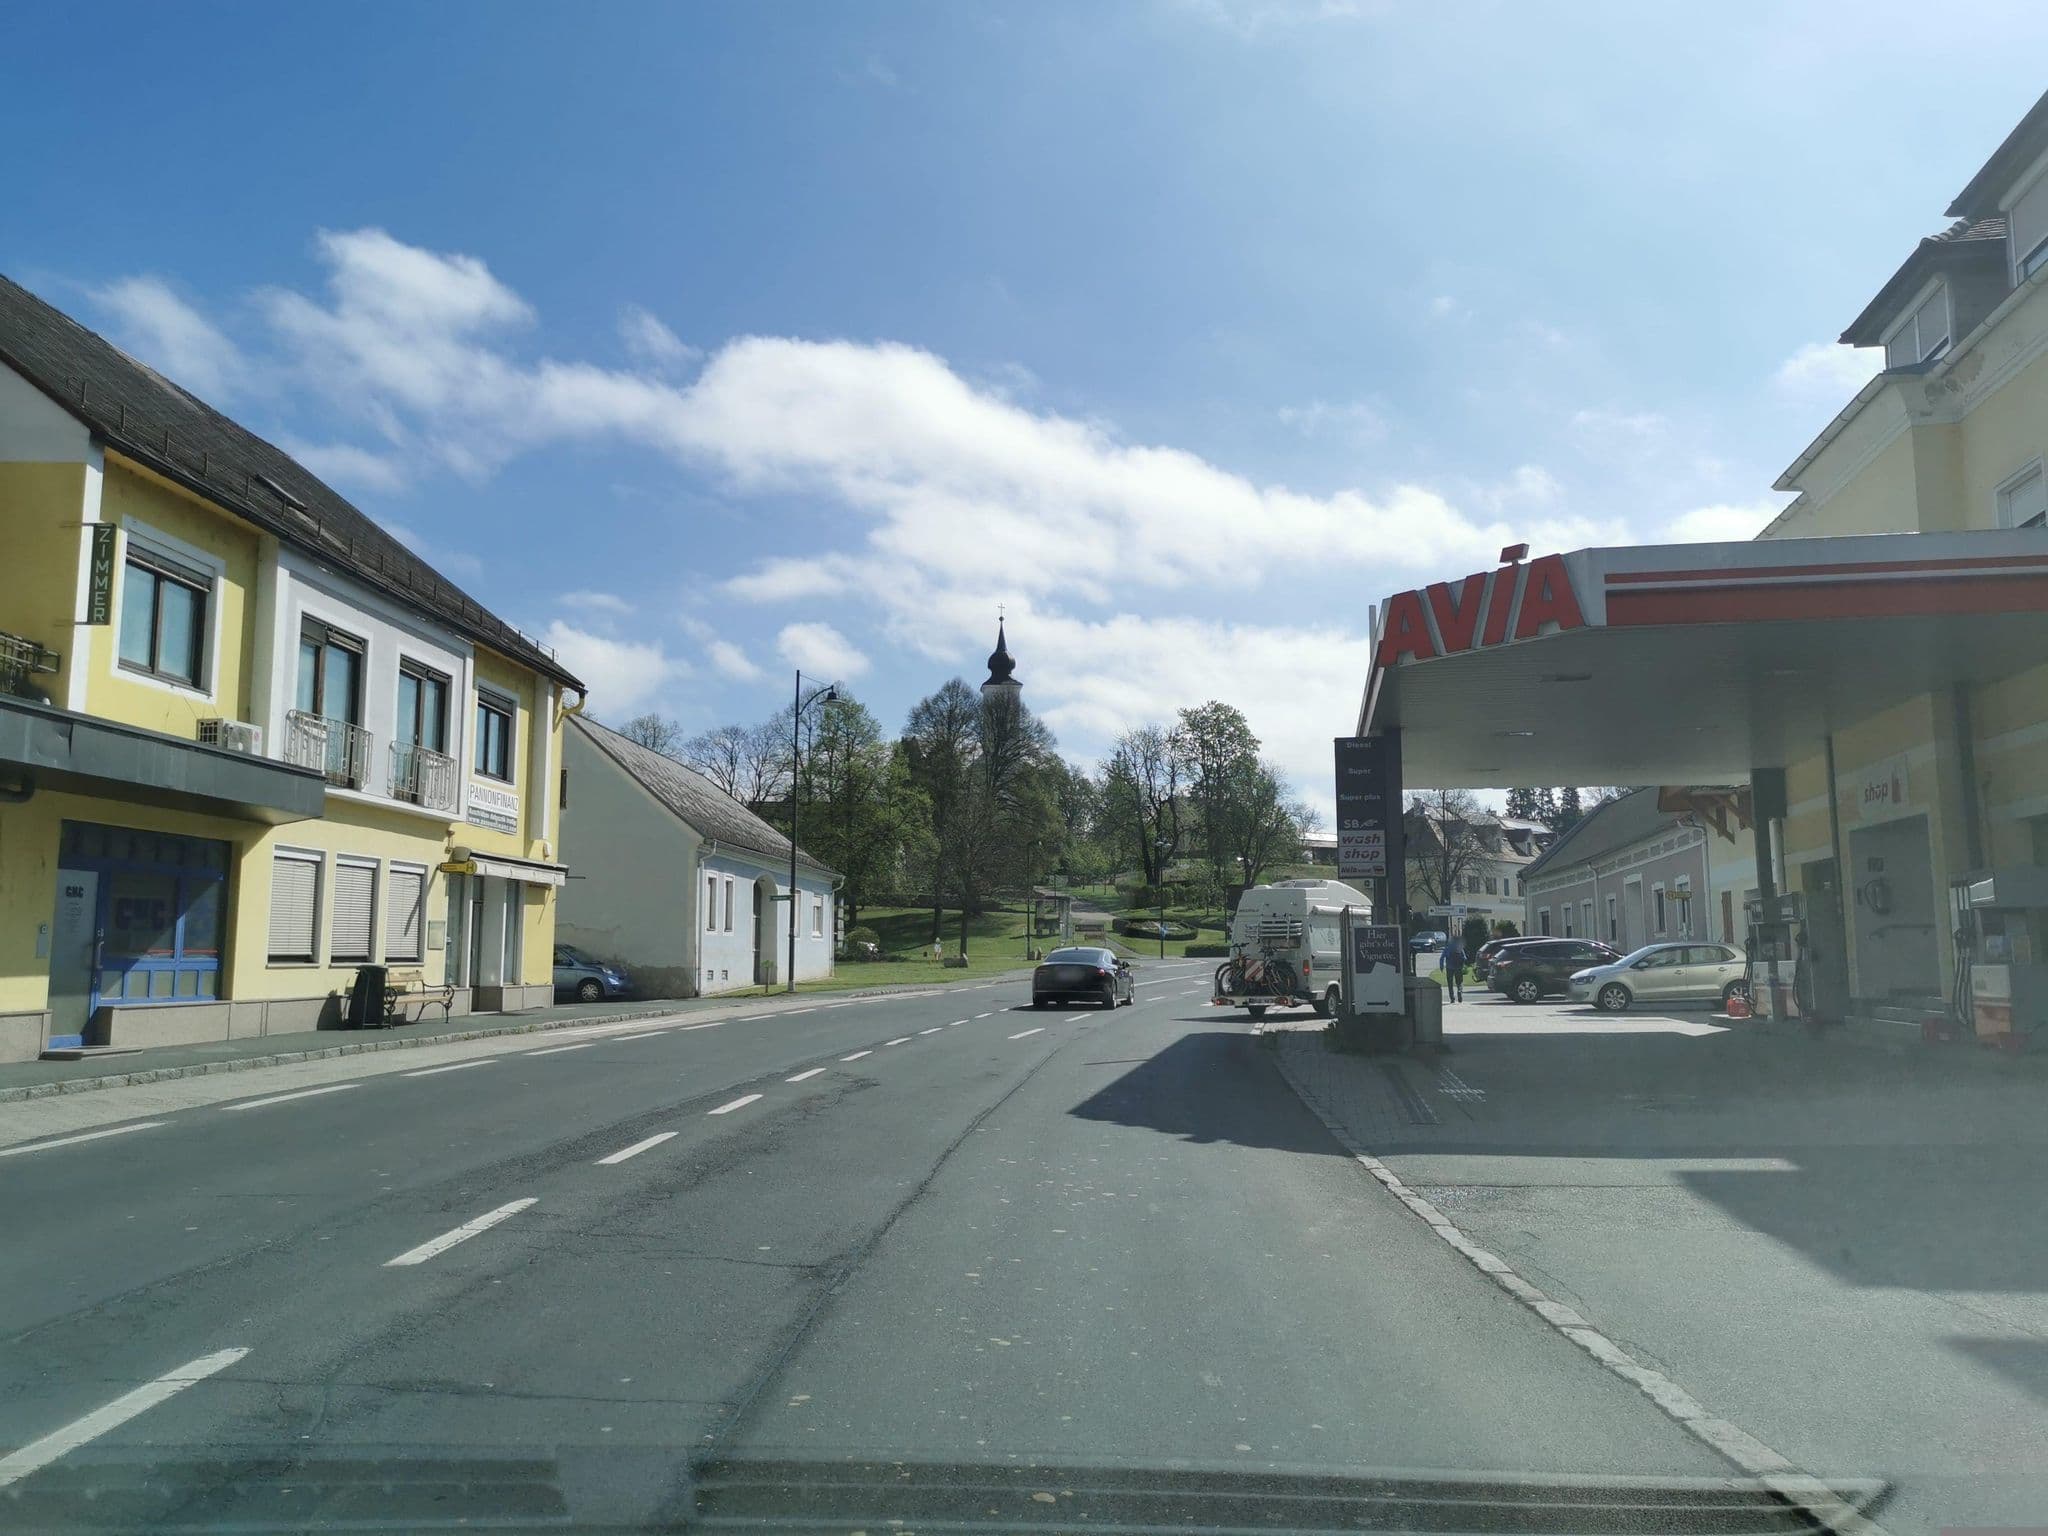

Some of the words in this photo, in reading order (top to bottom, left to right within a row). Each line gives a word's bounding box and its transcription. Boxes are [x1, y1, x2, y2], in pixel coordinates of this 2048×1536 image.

[93, 527, 111, 622] ZIMMER
[1377, 543, 1586, 668] AVIA
[469, 783, 519, 812] PANNONFINANZ
[1864, 781, 1889, 804] shop
[1343, 819, 1360, 829] SB
[1342, 834, 1381, 845] wash
[1343, 847, 1380, 861] shop
[1367, 929, 1387, 939] Hier
[1382, 938, 1395, 948] die
